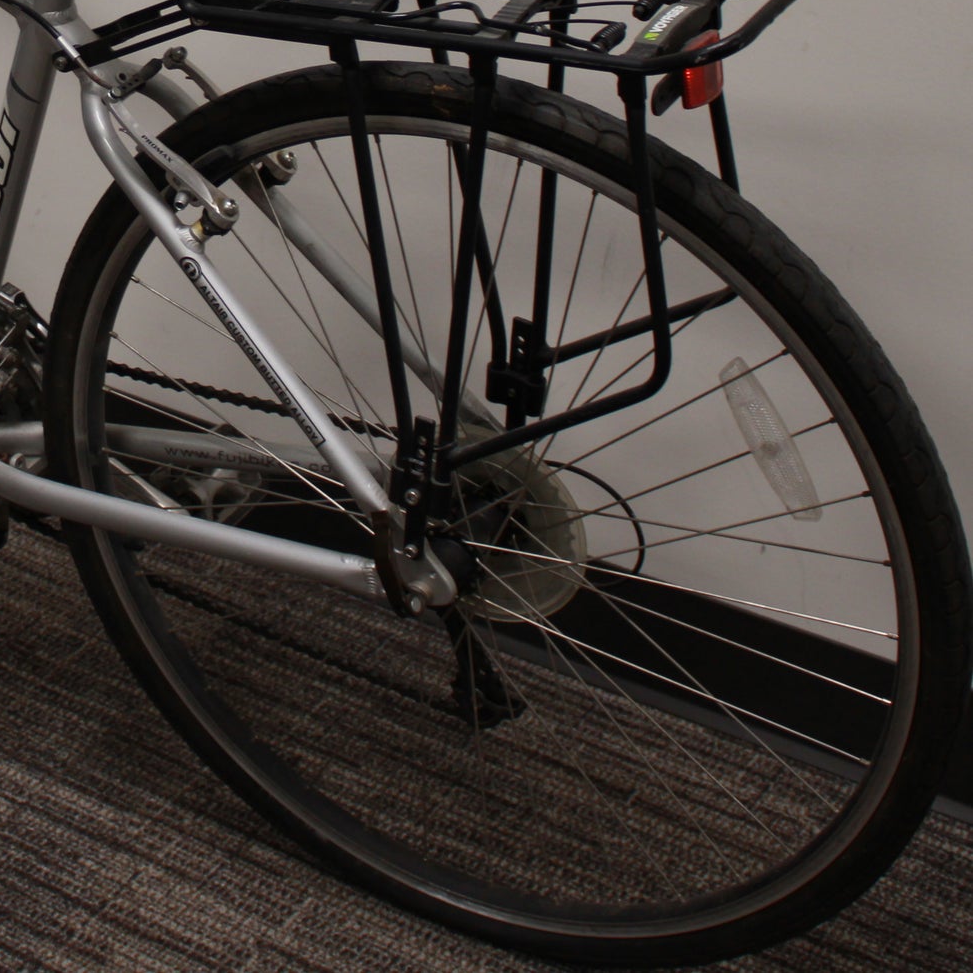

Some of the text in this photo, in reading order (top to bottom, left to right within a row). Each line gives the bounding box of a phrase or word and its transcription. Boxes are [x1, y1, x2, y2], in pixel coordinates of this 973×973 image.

[141, 134, 173, 163] PROMAX
[198, 285, 319, 441] ALTAIR CUSTOM BUTTED ALLOY
